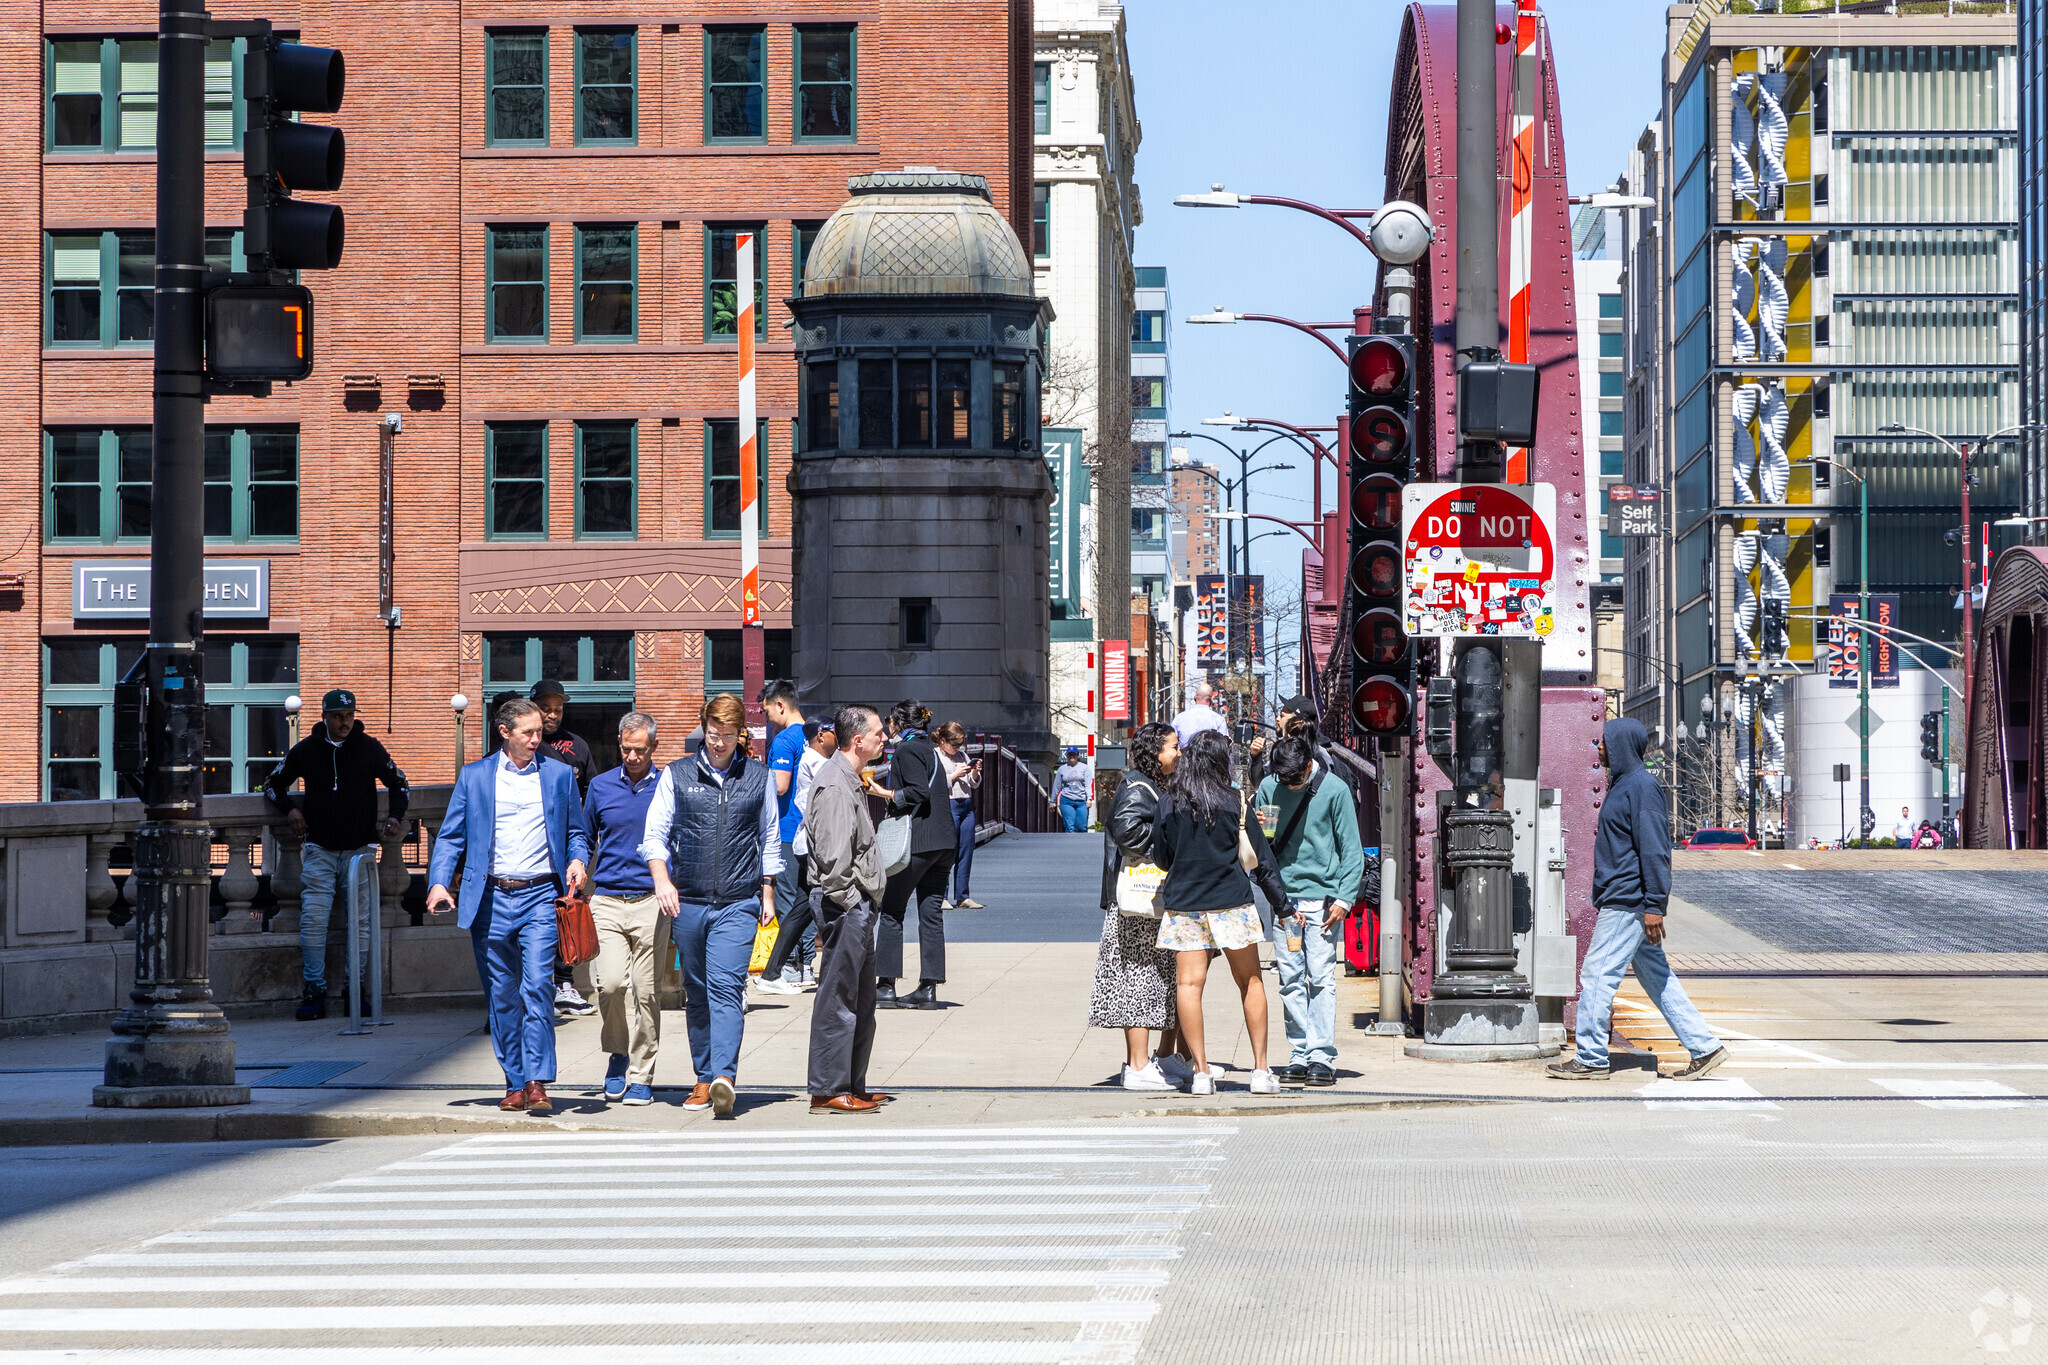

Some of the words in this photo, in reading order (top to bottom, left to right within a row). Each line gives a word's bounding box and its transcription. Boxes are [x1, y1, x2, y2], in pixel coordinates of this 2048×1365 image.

[283, 306, 303, 359] 7
[1450, 501, 1476, 513] SUNNIE
[1622, 504, 1653, 519] Self
[1428, 516, 1460, 538] DO
[1480, 516, 1530, 538] NOT
[1622, 520, 1657, 534] Park
[1197, 594, 1211, 661] RIVER
[1211, 582, 1226, 661] NORTH
[1438, 612, 1456, 622] MUST
[1442, 624, 1460, 634] RICH
[1829, 614, 1843, 681] RIVER
[1843, 602, 1859, 681] NORTH
[1879, 635, 1890, 673] RIGHT
[1104, 649, 1125, 711] NONNINA
[1645, 768, 1661, 777] way
[1128, 861, 1167, 878] Vintag
